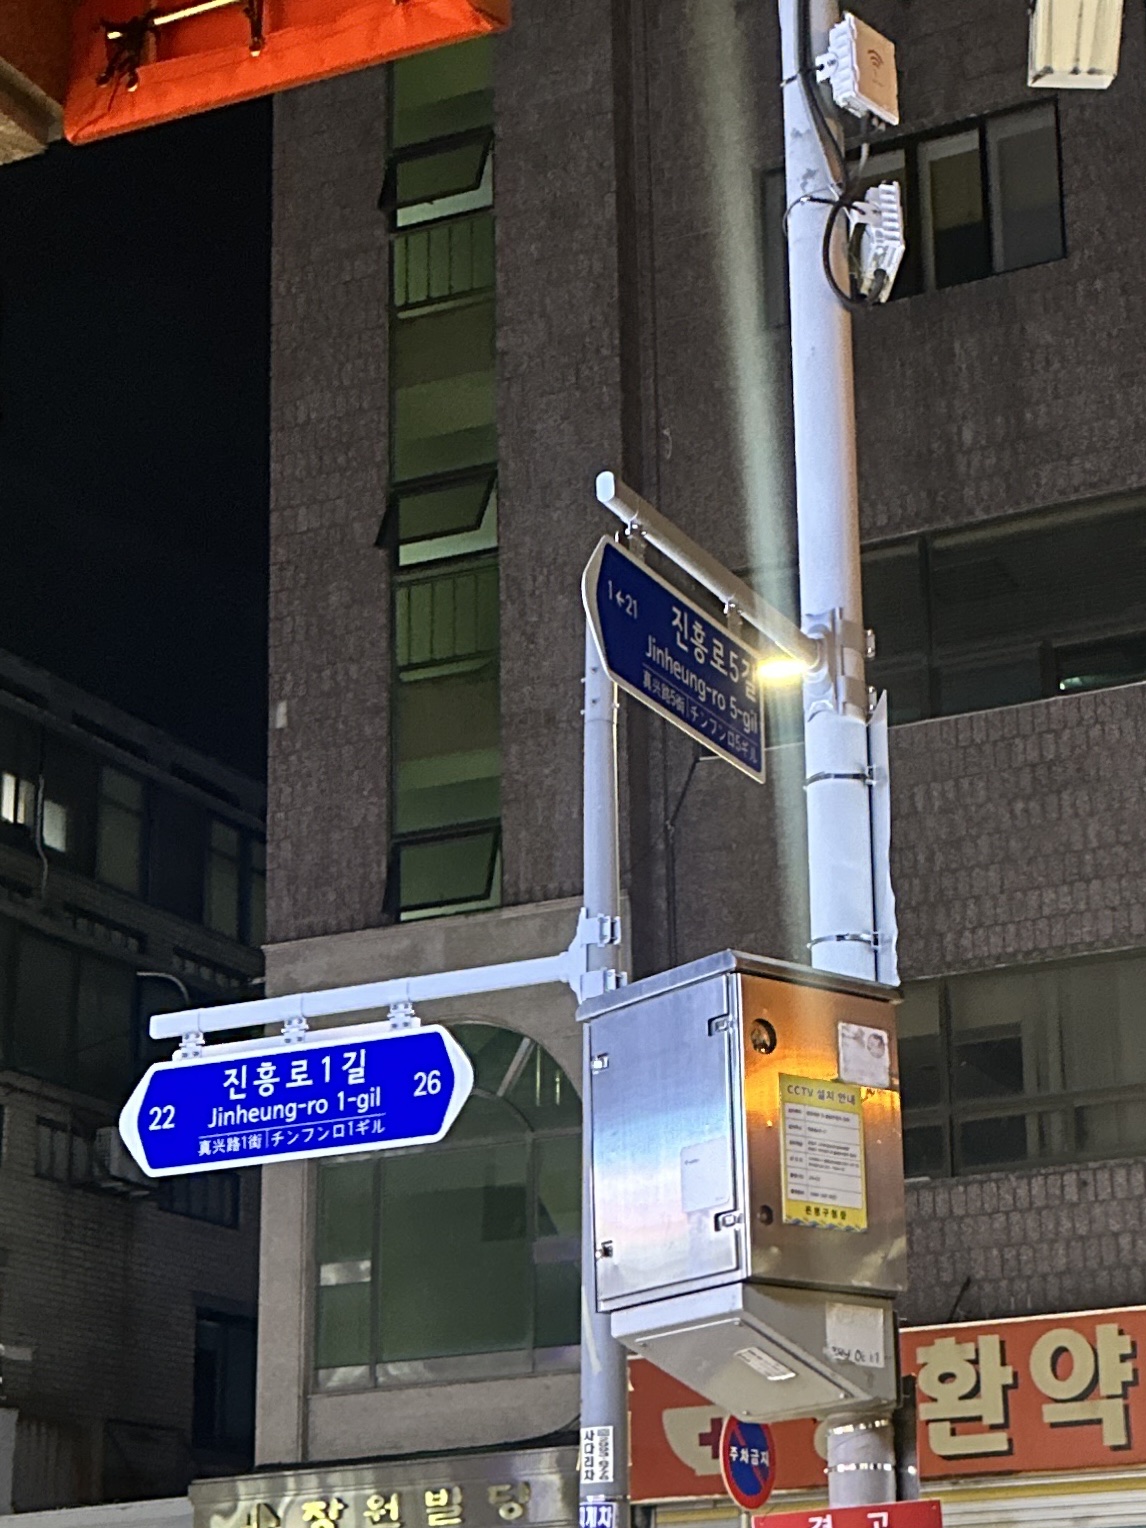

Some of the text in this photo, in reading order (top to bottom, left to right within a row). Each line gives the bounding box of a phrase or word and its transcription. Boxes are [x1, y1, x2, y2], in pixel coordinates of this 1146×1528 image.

[647, 635, 758, 735] Jinheung-ro 5-gil
[222, 1048, 366, 1100] 진흥로1길
[413, 1070, 441, 1097] 26
[787, 1084, 814, 1098] CCTV
[149, 1105, 176, 1131] 22
[207, 1087, 381, 1129] Jinheung-ro 1-gil
[730, 1445, 770, 1468] 주차금지
